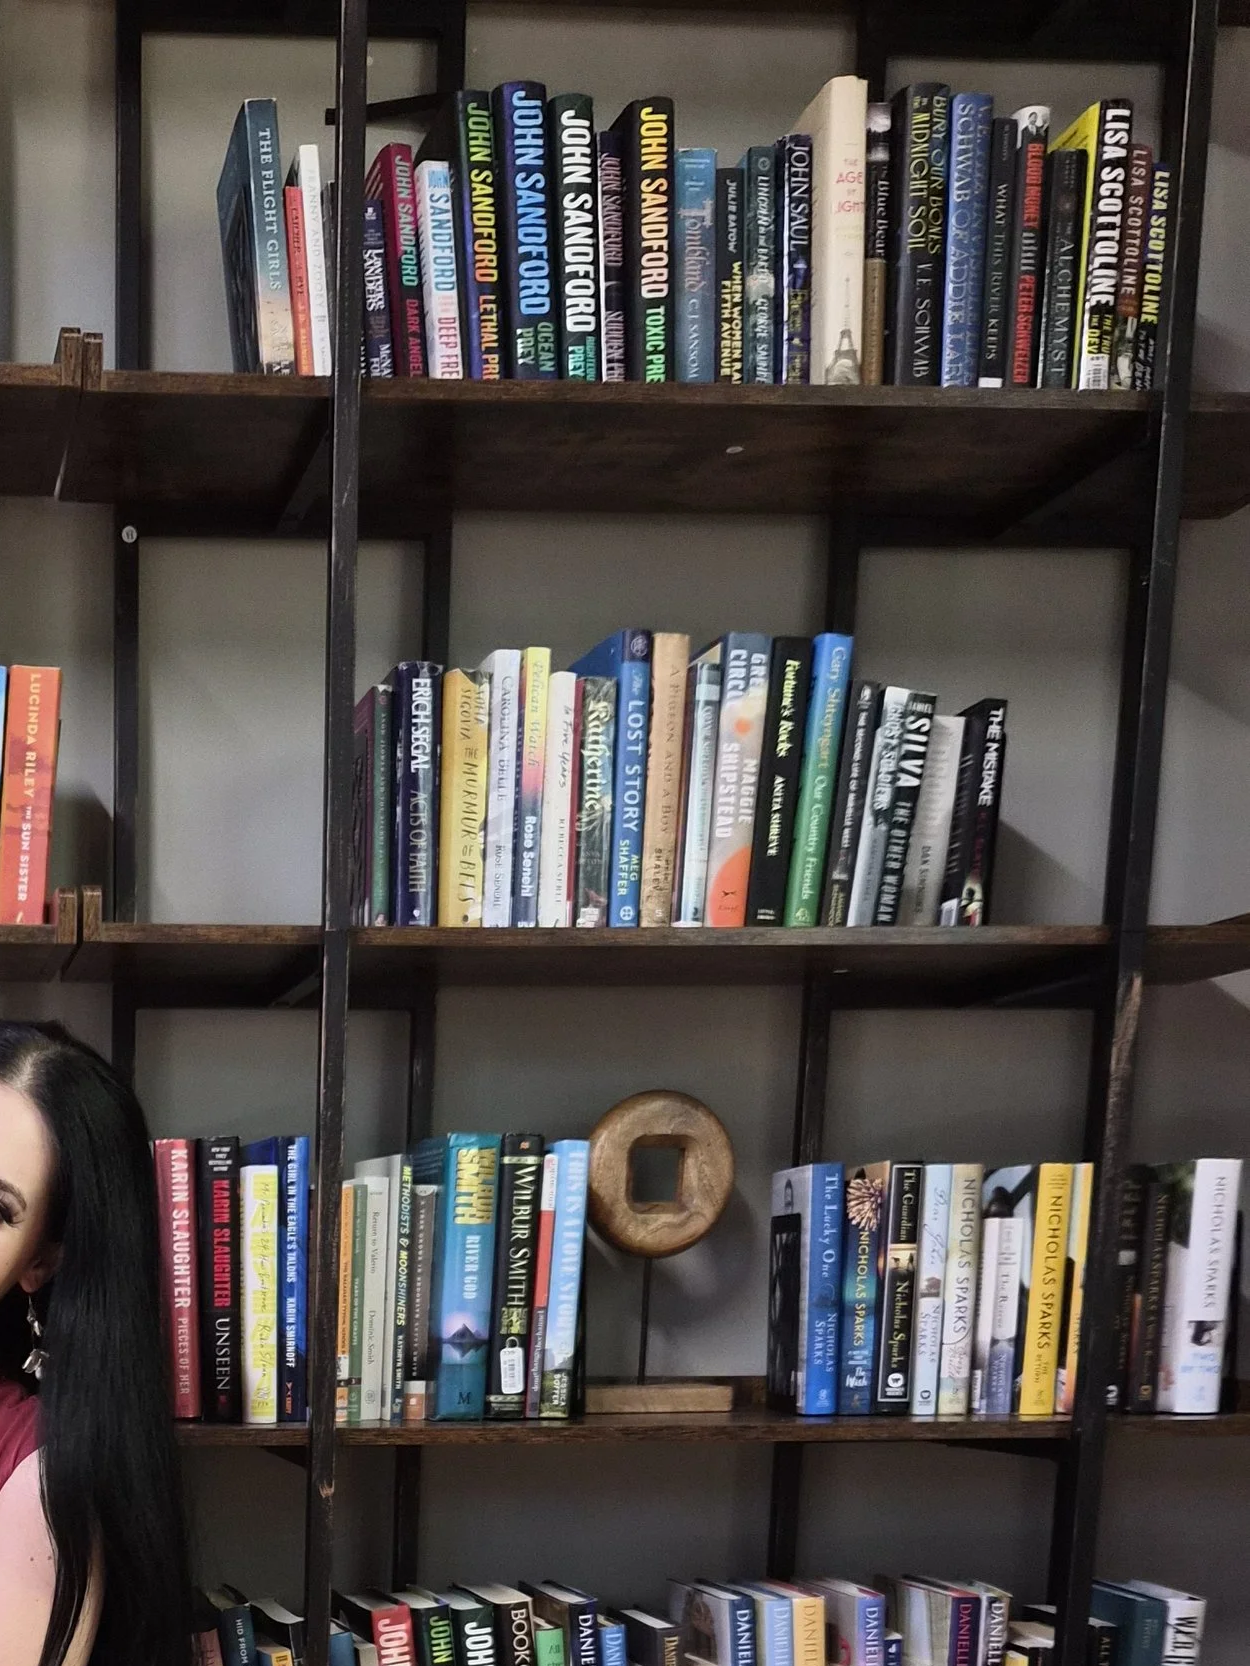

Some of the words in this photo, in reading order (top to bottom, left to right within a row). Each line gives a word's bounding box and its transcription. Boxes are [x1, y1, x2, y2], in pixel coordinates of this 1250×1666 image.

[512, 90, 544, 166] JOHN
[561, 109, 592, 185] JOHN
[640, 106, 668, 171] JOHN
[1102, 108, 1130, 160] LISA
[1153, 170, 1170, 210] LISA
[515, 172, 550, 316] SANDFORD
[563, 193, 597, 333] SANDFORD
[640, 177, 670, 299] SANDFORD
[1090, 166, 1124, 306] SCOTTOLINE
[721, 280, 731, 316] FIFTH
[1141, 215, 1166, 323] SCOTTOLINE
[626, 700, 645, 755] LOST
[895, 716, 931, 787] SILVA
[624, 764, 641, 833] STORY
[524, 815, 537, 847] Rose
[520, 851, 536, 897] Senehl
[617, 840, 630, 897] SHAFFER
[171, 1149, 189, 1203] KARIN
[212, 1179, 230, 1225] KARIN
[400, 1165, 412, 1236] METHODISTS
[510, 1165, 536, 1241] WILBUR
[825, 1173, 838, 1200] The
[820, 1203, 837, 1246] Lucky
[1042, 1195, 1062, 1286] NICHOLAS
[172, 1208, 191, 1309] SLAUGHTER
[214, 1229, 231, 1308] SLAUGHTER
[508, 1247, 529, 1307] SMITH
[822, 1251, 835, 1278] One
[397, 1251, 408, 1327] MOONSHINERS
[178, 1318, 189, 1355] PIECES
[285, 1325, 295, 1368] SMIRNOFF
[1037, 1293, 1055, 1349] SPARKS
[179, 1359, 189, 1372] OF
[214, 1318, 230, 1391] UNSEEN
[179, 1376, 189, 1395] HER
[511, 1609, 531, 1664] BOOK
